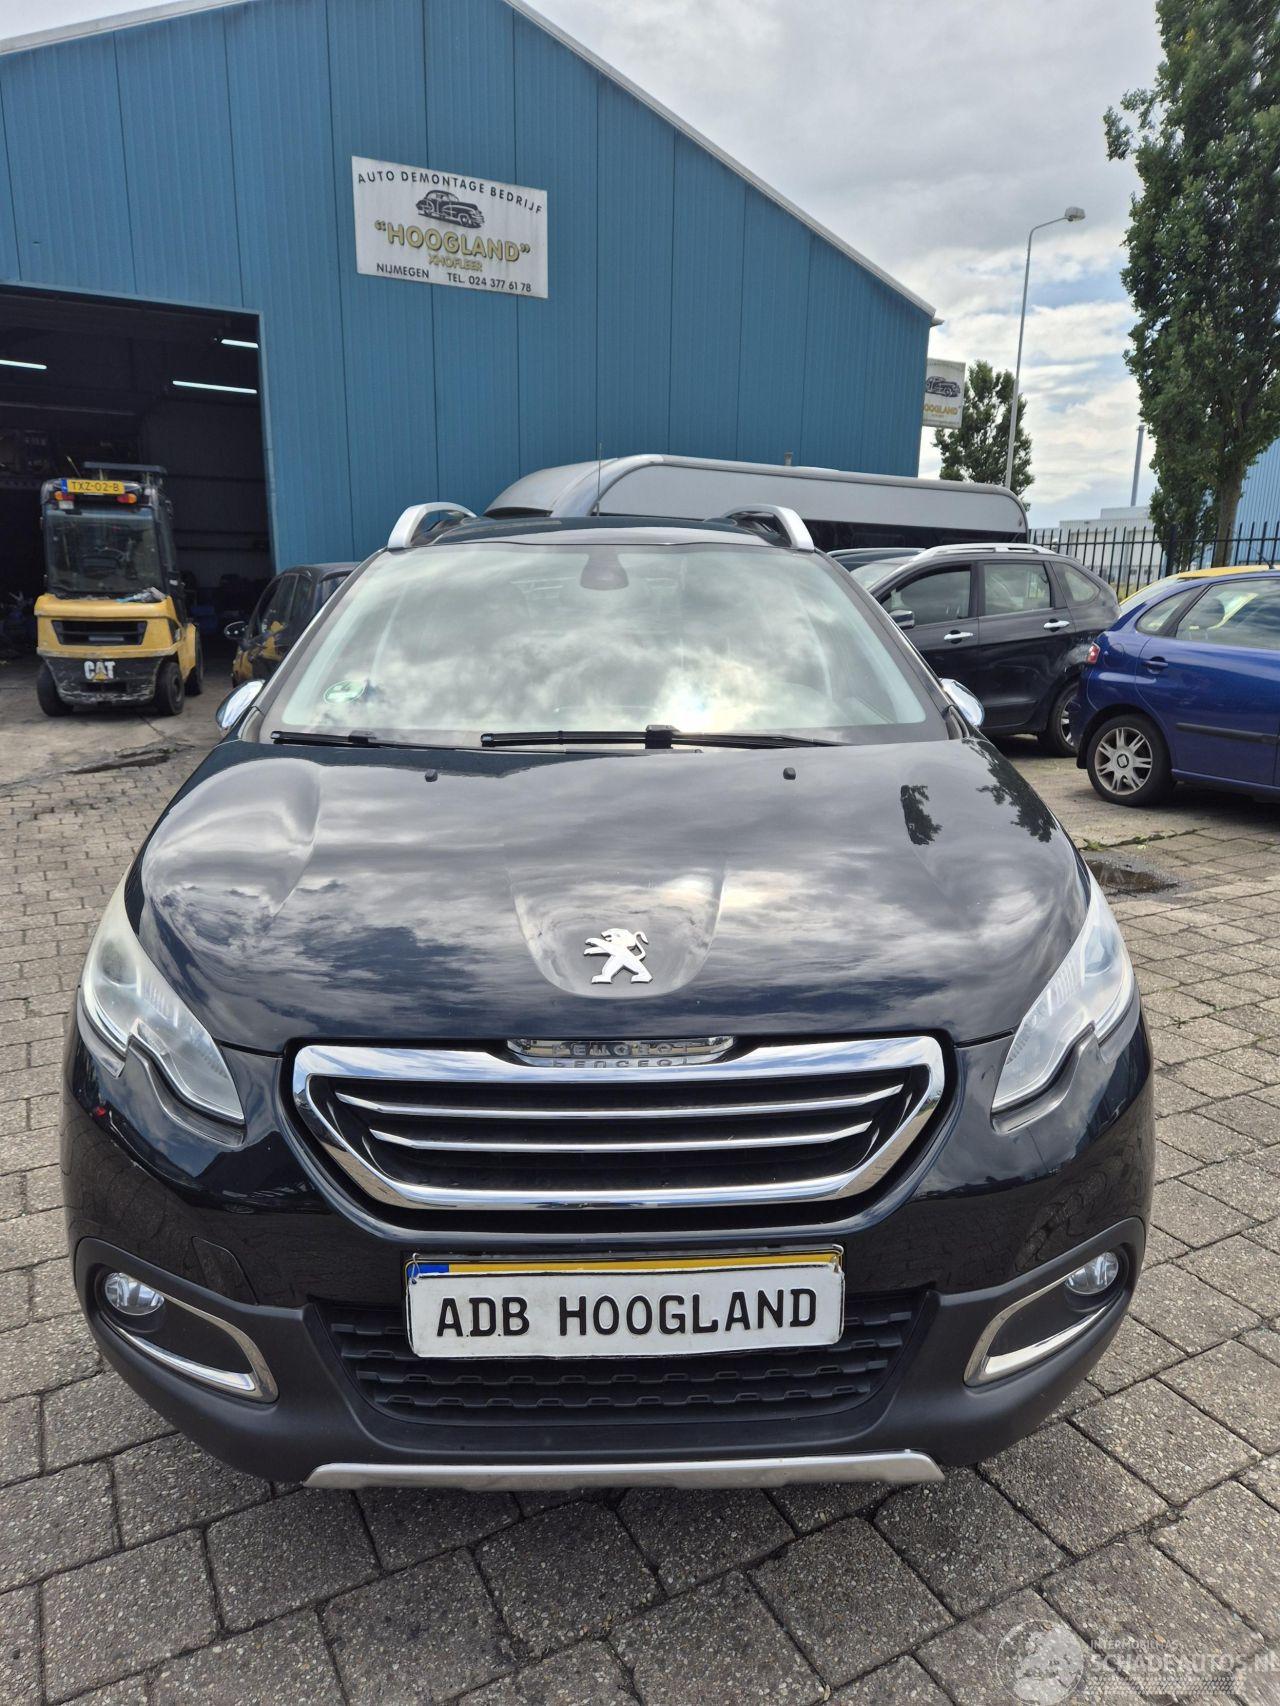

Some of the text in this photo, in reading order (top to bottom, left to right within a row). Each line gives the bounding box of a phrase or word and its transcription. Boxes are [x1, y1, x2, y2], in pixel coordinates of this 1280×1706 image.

[358, 170, 543, 214] AUTO DEMONTAGE BEDRIJF
[374, 219, 531, 262] “HOOGLAND”
[376, 262, 532, 292] NIJMEGEN TEL. 024 377 61 78
[71, 481, 120, 492] TXZ-02-B
[84, 660, 116, 681] CAT
[559, 1287, 818, 1336] HOOGLAND
